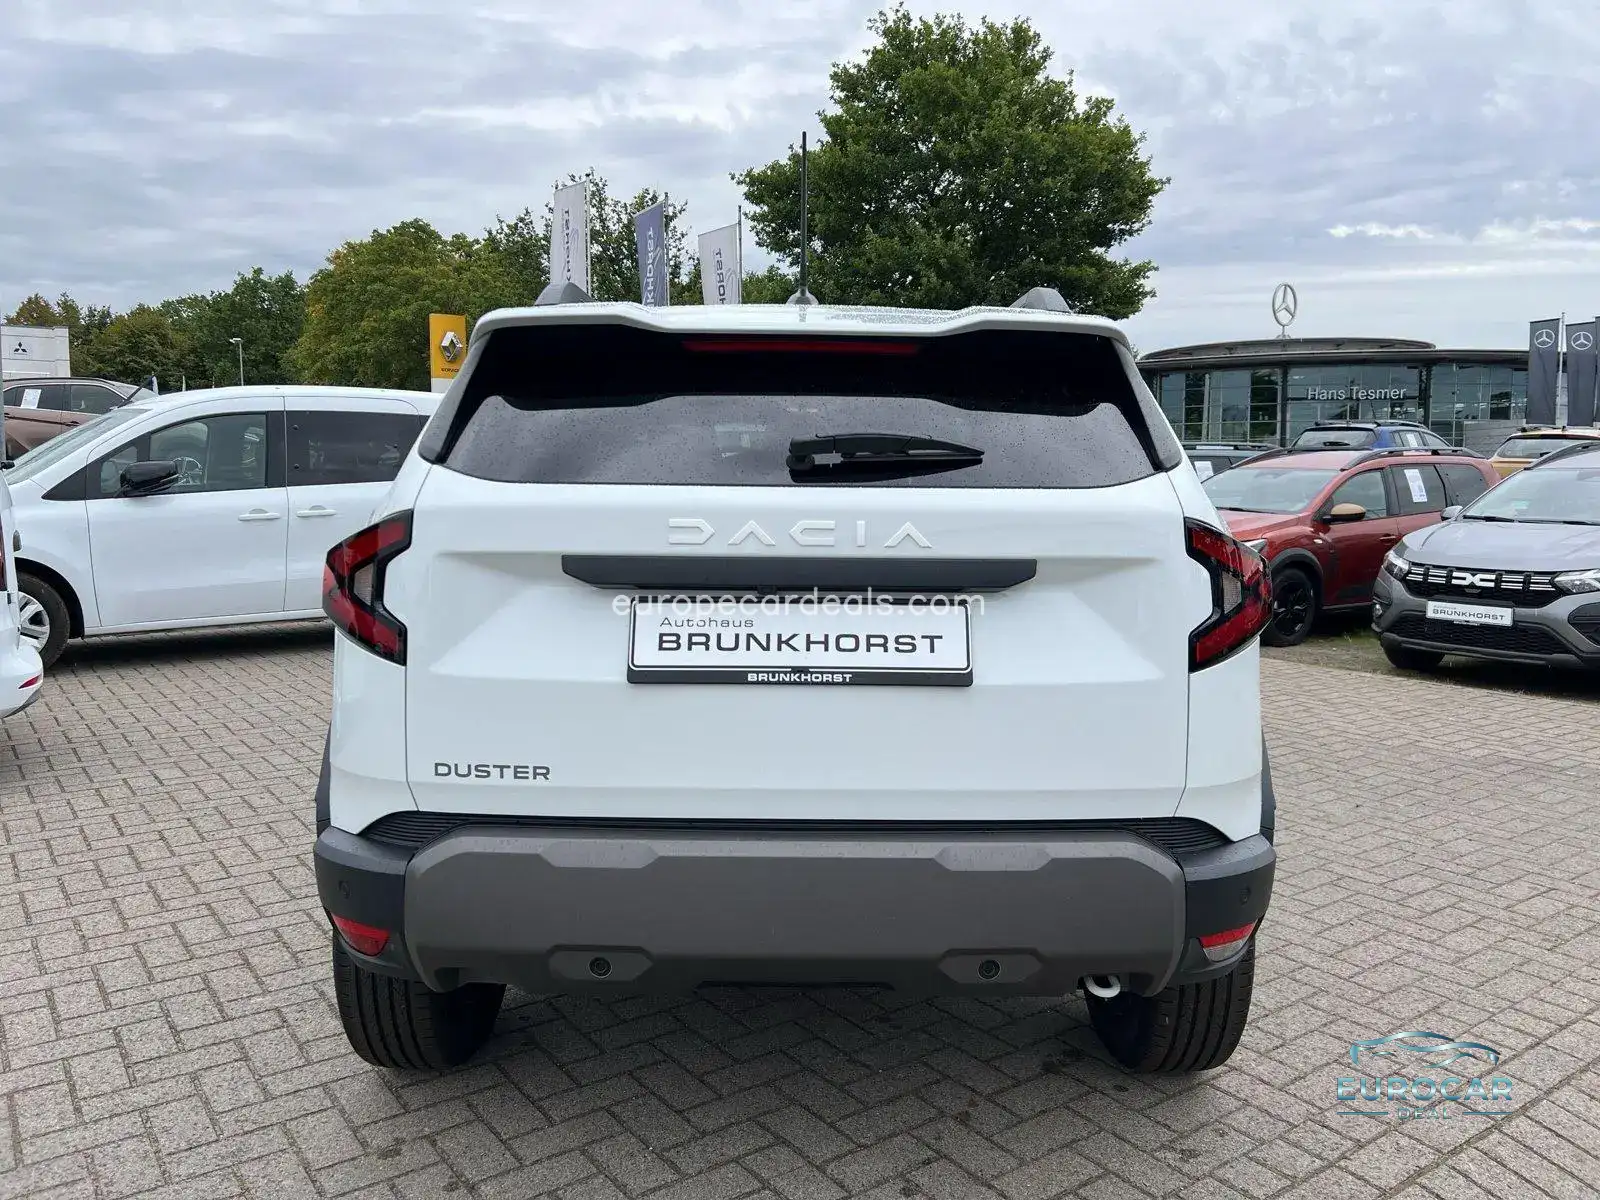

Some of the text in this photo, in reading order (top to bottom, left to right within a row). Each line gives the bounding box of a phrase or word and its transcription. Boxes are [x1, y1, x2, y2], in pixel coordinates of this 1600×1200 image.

[1307, 386, 1407, 400] Hans Tesmer
[668, 518, 932, 548] DACIA
[1432, 608, 1506, 621] BRUNKHORST
[660, 617, 754, 628] Autohaus
[658, 632, 944, 654] BRUNKHORST
[747, 672, 853, 683] BRUNKHORST
[434, 762, 550, 781] DUSTER
